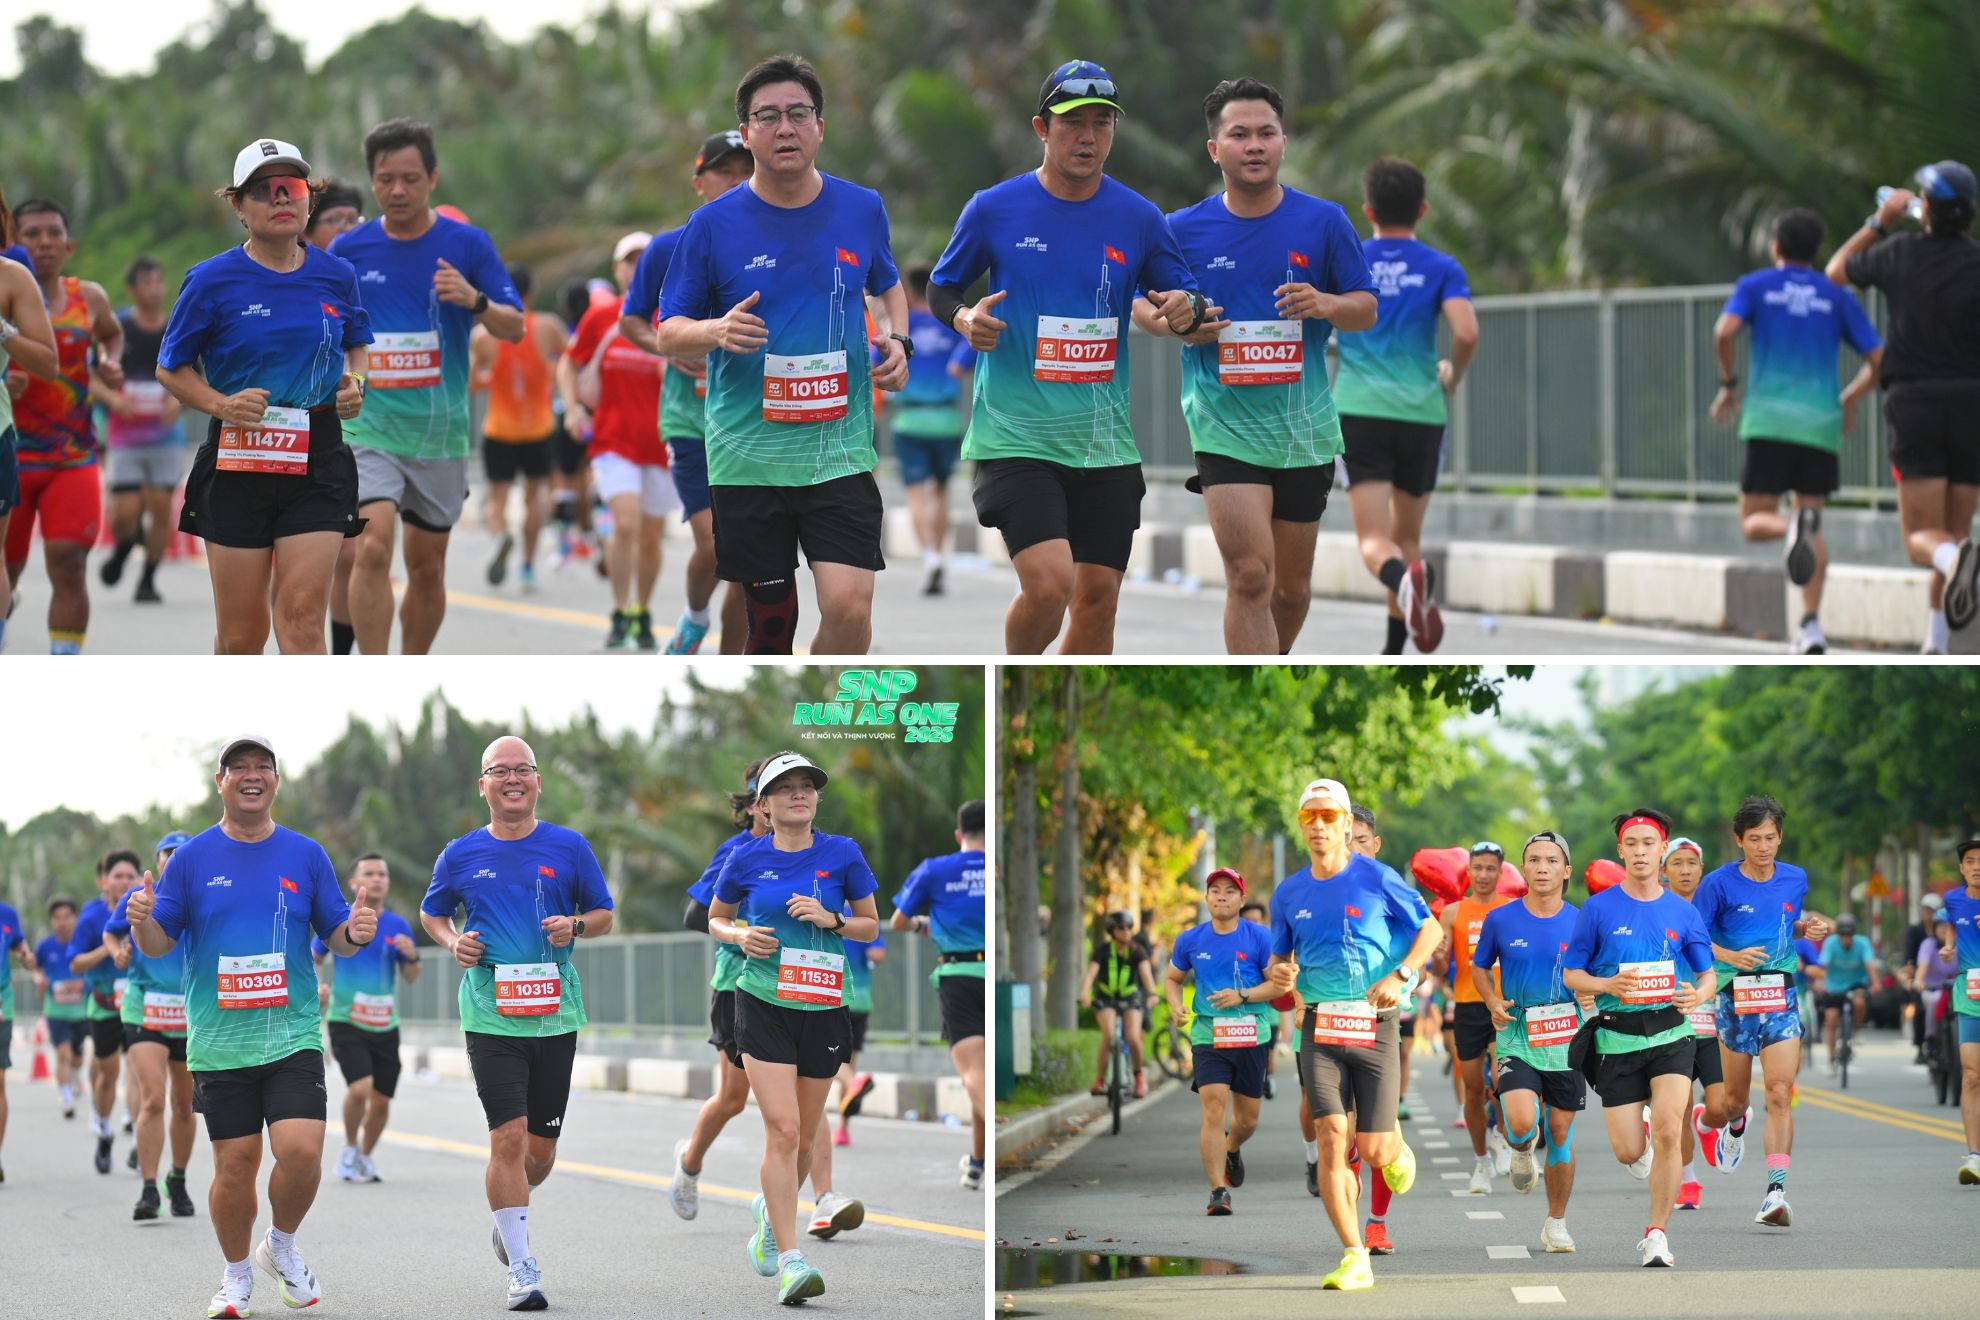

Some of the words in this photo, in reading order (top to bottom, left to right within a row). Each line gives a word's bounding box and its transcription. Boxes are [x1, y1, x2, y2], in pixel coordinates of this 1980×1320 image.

[1063, 343, 1108, 358] 10177
[1242, 345, 1297, 361] 10047
[387, 353, 430, 368] 10215
[789, 378, 839, 397] 10165
[245, 431, 297, 448] 11477
[236, 973, 282, 989] 10360
[801, 970, 836, 986] 11533
[1638, 977, 1670, 989] 10010
[516, 982, 554, 996] 10315
[1749, 989, 1782, 999] 10334
[1226, 1026, 1255, 1036] 10009
[1332, 1016, 1372, 1031] 10095
[1543, 1018, 1571, 1032] 10141
